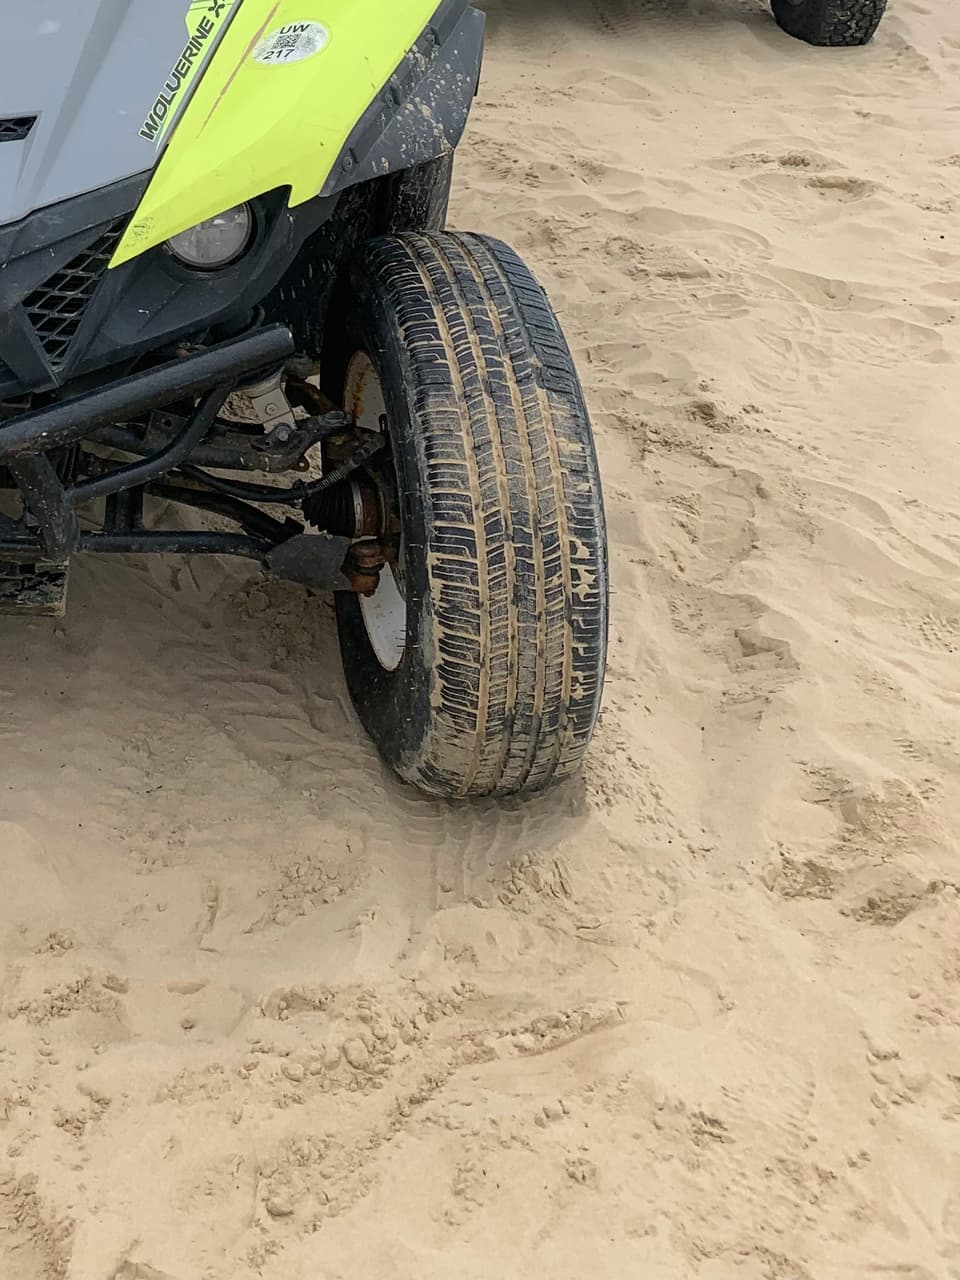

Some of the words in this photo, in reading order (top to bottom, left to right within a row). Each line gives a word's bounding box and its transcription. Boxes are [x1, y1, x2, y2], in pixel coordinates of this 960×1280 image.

[279, 23, 310, 35] UW
[262, 48, 296, 60] 217
[140, 15, 215, 141] WOLVERINE
